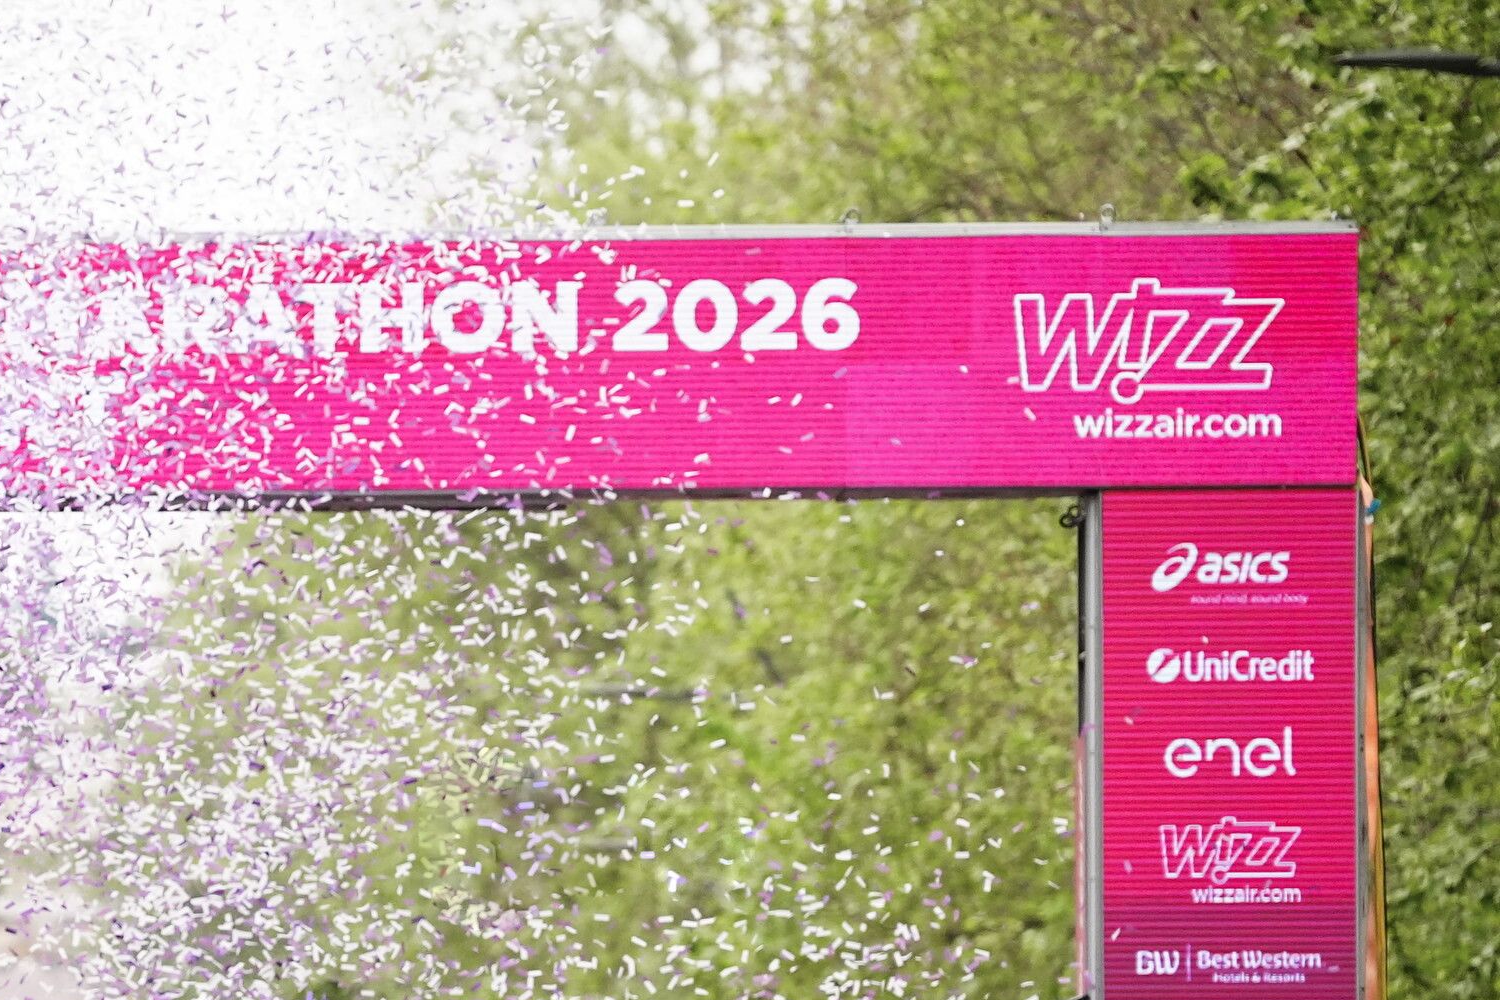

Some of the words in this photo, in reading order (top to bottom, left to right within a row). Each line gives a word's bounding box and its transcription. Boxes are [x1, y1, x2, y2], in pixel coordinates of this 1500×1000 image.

[611, 277, 861, 352] 2026
[1073, 411, 1283, 439] wizzair.com
[1184, 650, 1315, 682] UniCredit
[1164, 726, 1297, 778] enel
[1192, 885, 1302, 904] wizzair.com
[1197, 949, 1240, 970] Best
[1243, 949, 1322, 969] Western
